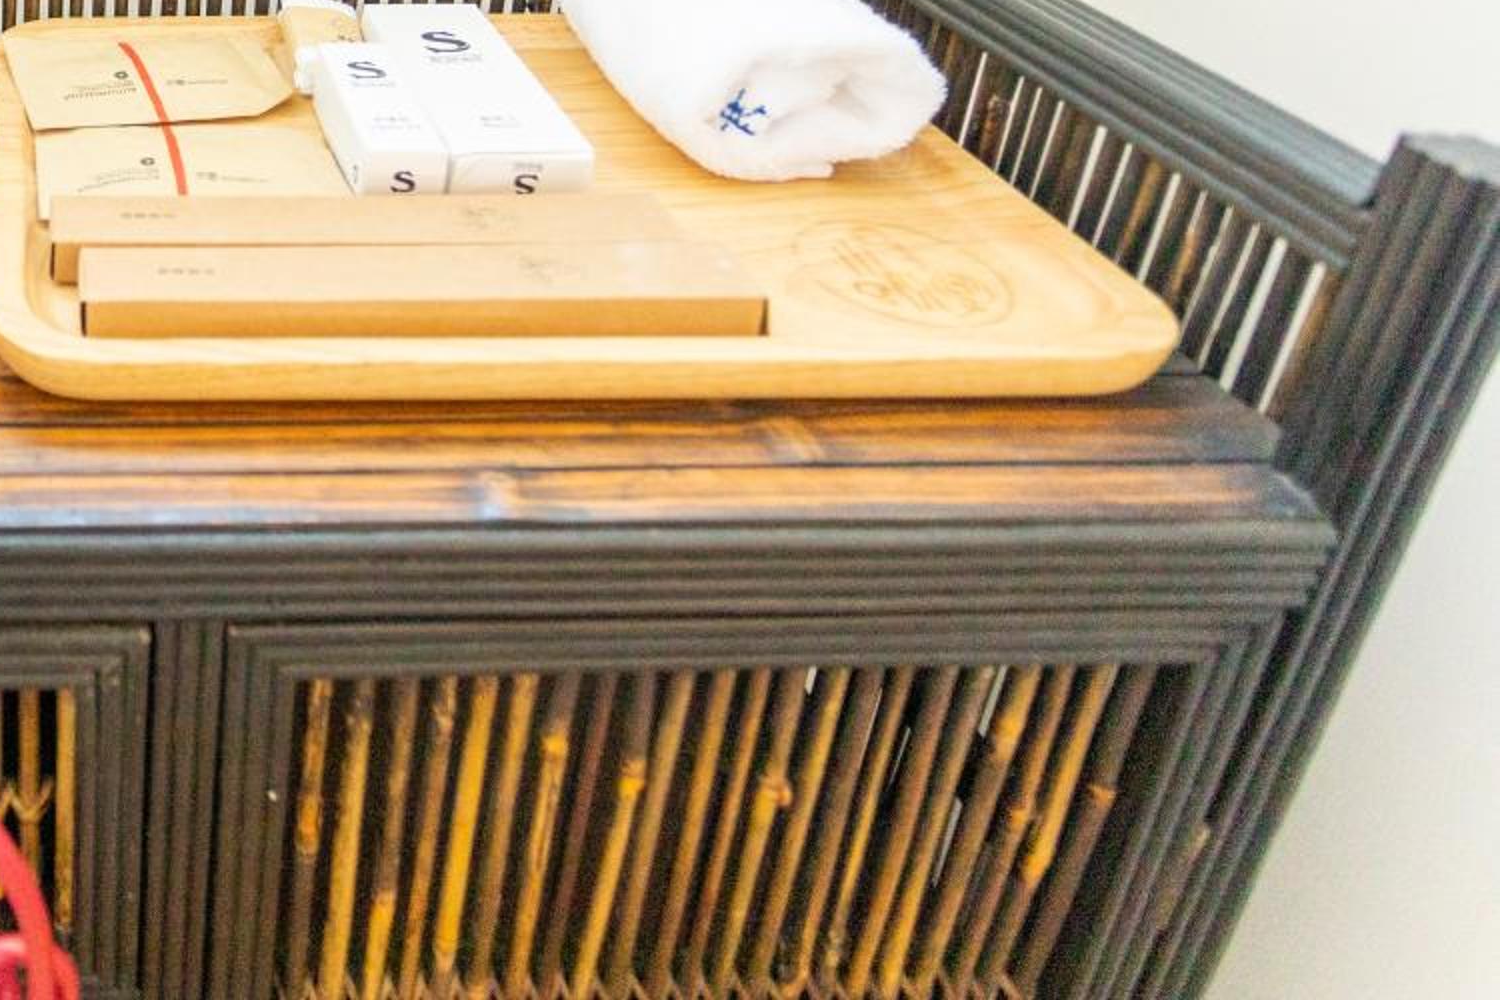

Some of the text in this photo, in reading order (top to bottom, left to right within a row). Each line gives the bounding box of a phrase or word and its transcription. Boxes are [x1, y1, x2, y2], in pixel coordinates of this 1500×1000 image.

[421, 31, 471, 53] S
[346, 60, 387, 79] S
[389, 169, 417, 194] S
[513, 173, 540, 195] S
